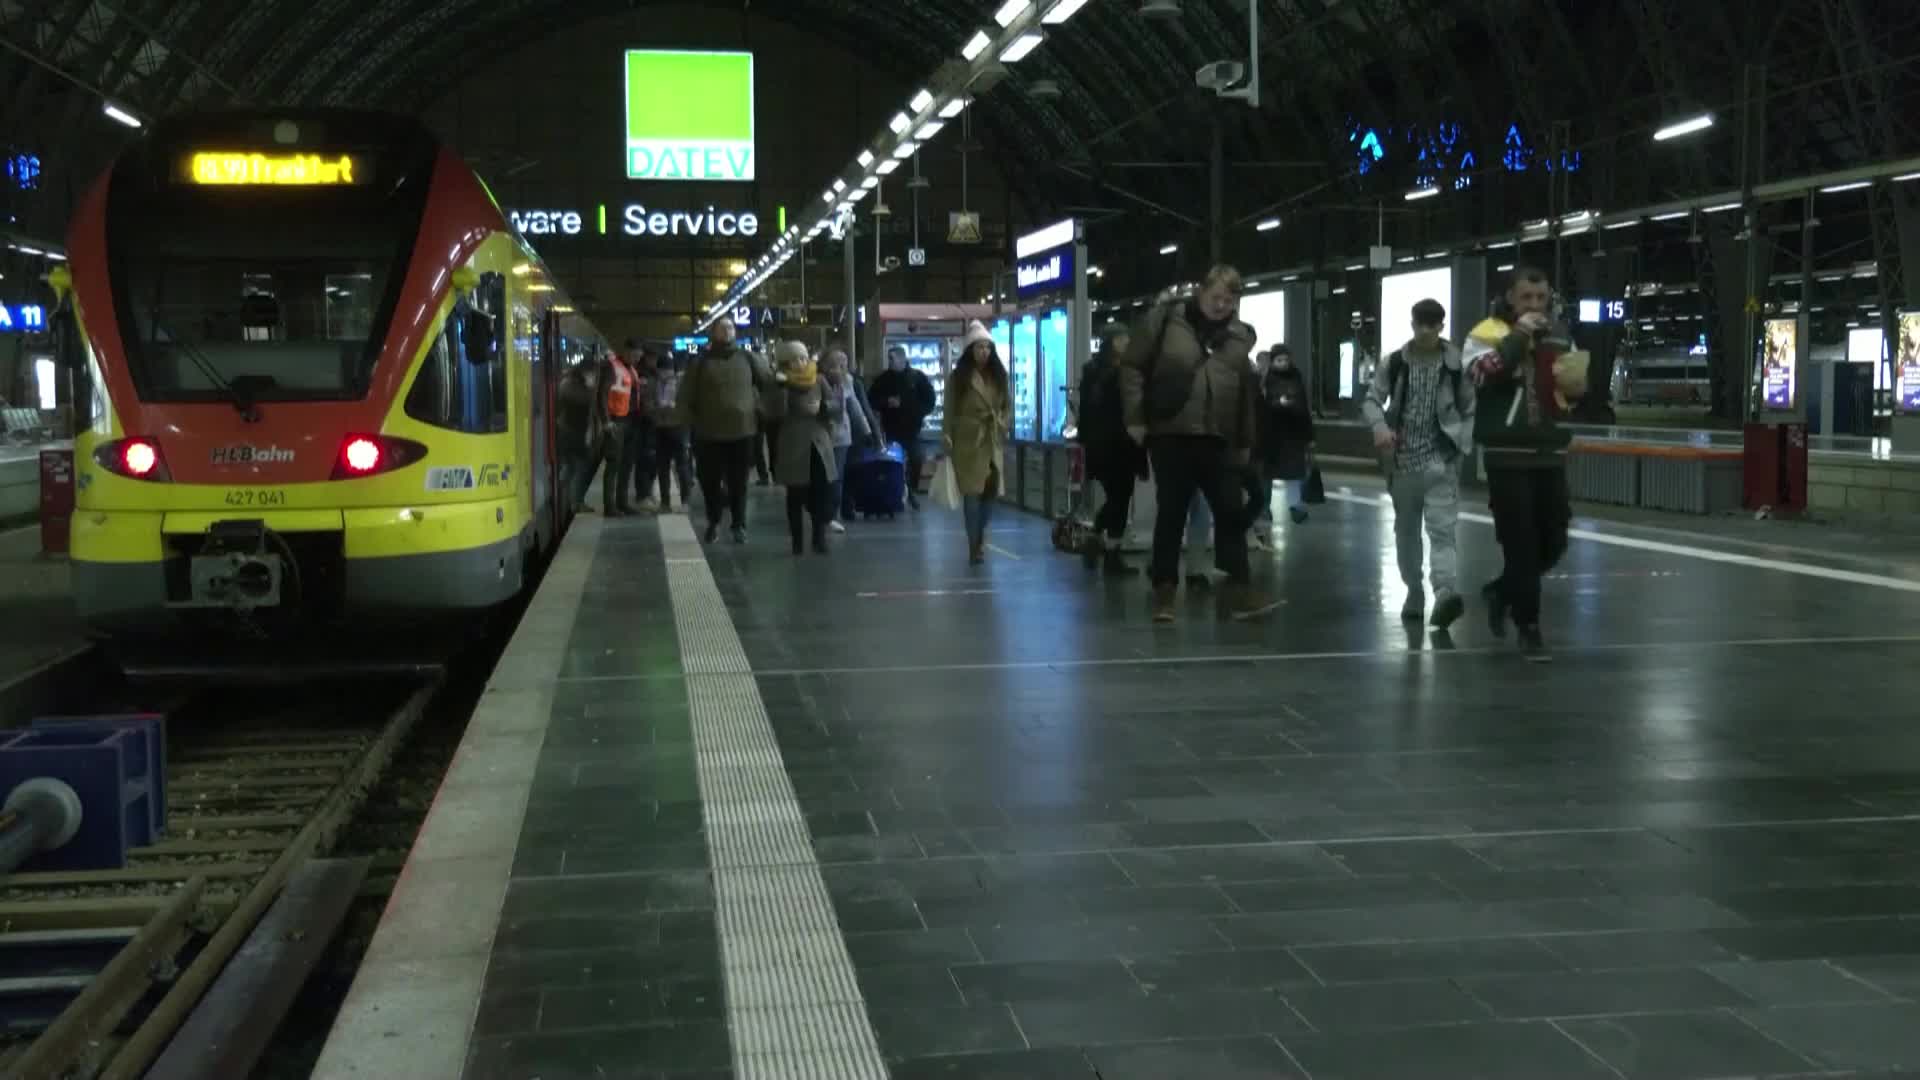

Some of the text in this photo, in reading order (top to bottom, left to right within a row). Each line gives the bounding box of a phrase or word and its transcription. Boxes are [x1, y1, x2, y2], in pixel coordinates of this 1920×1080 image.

[629, 146, 751, 178] DATEV
[624, 205, 758, 236] Service
[22, 305, 41, 325] 11
[732, 306, 751, 325] 12
[1606, 301, 1624, 319] 15
[225, 490, 285, 505] 427 041
